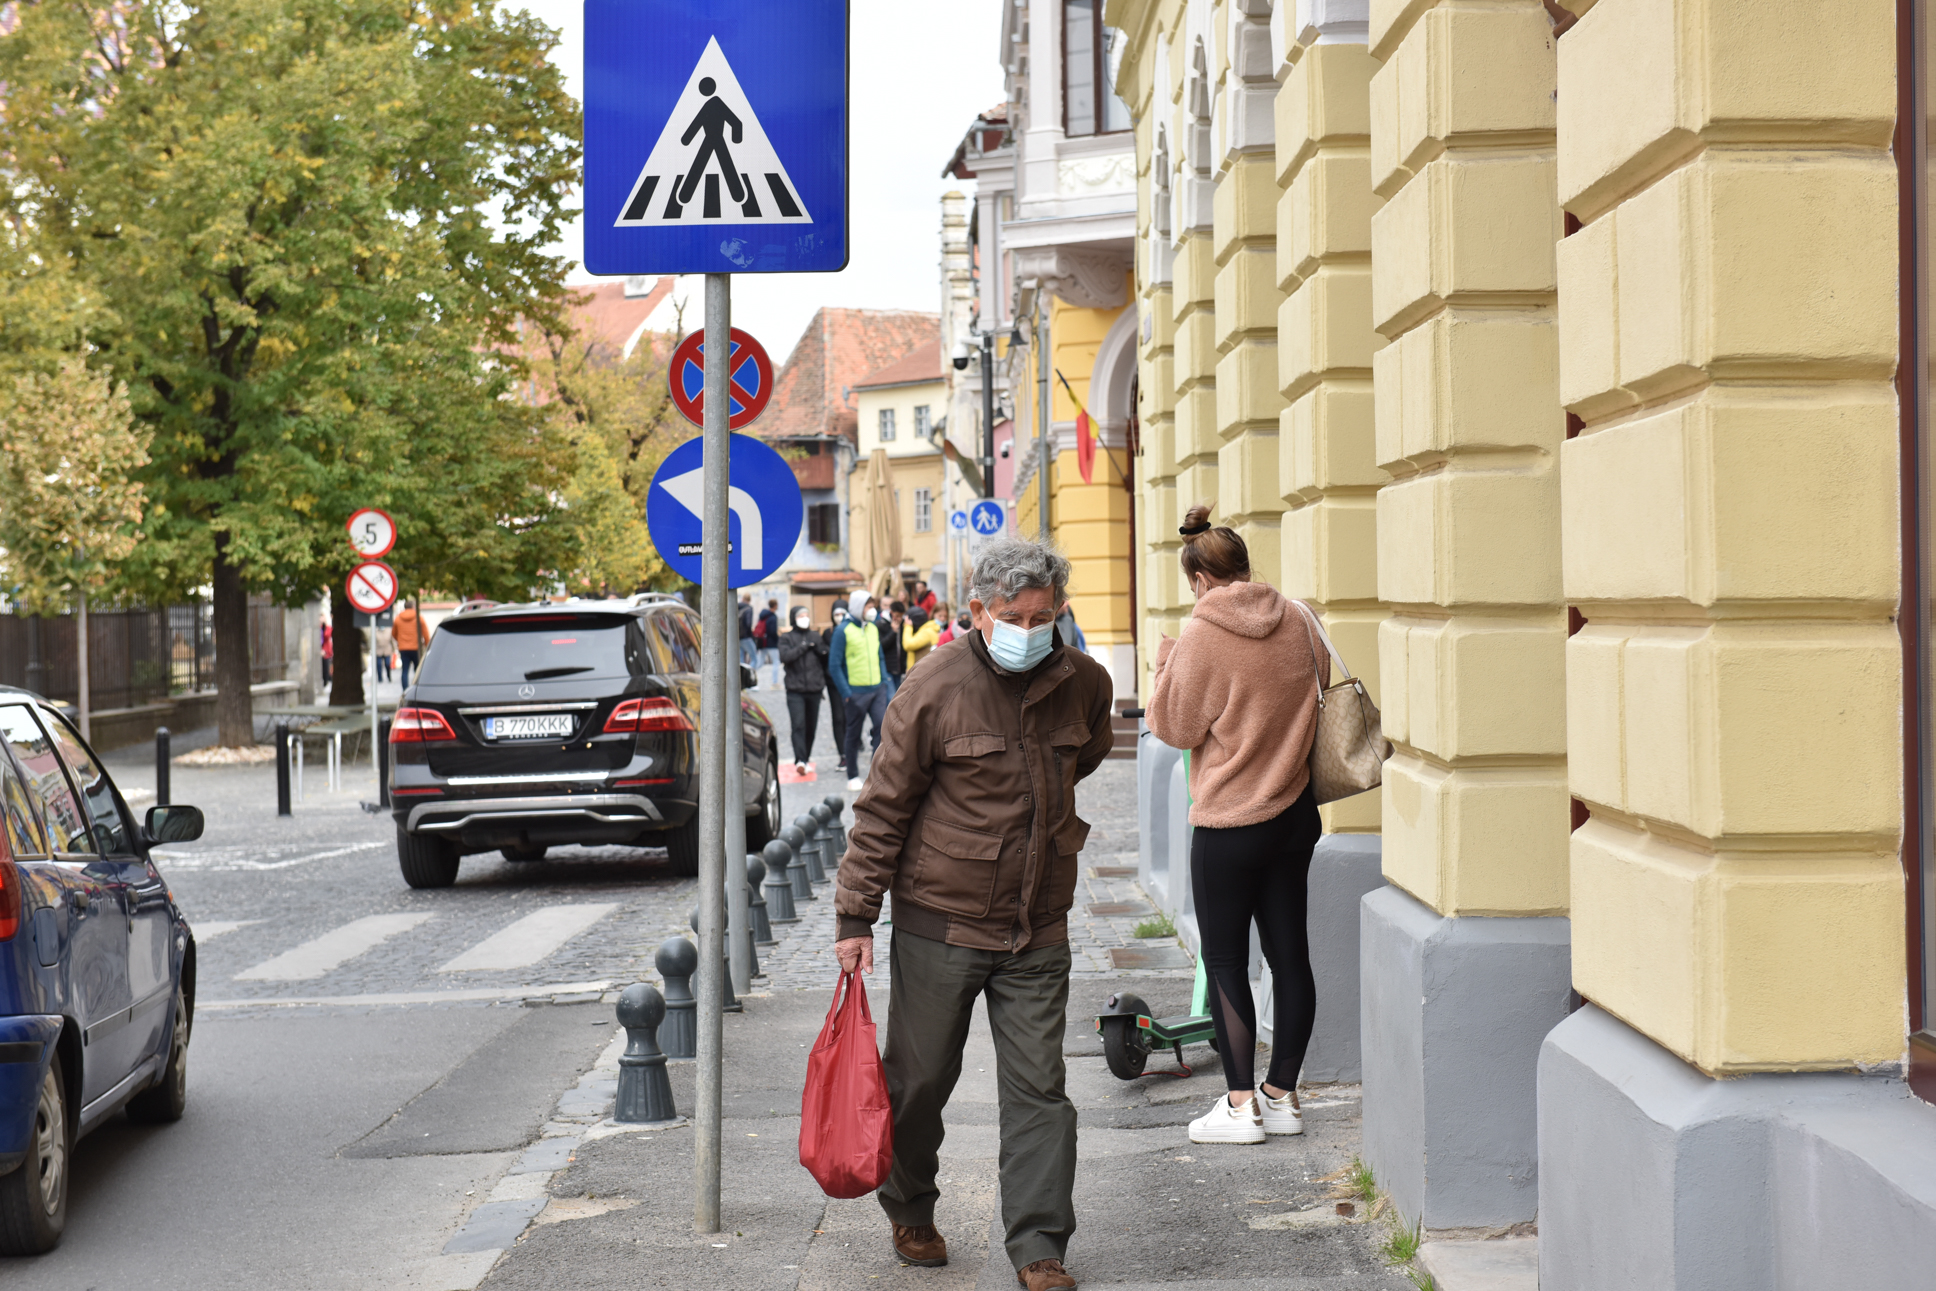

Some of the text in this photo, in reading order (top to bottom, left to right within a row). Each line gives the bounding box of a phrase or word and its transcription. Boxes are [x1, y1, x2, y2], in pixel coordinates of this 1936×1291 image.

[366, 522, 377, 545] 5
[494, 716, 569, 733] B 770KKK
